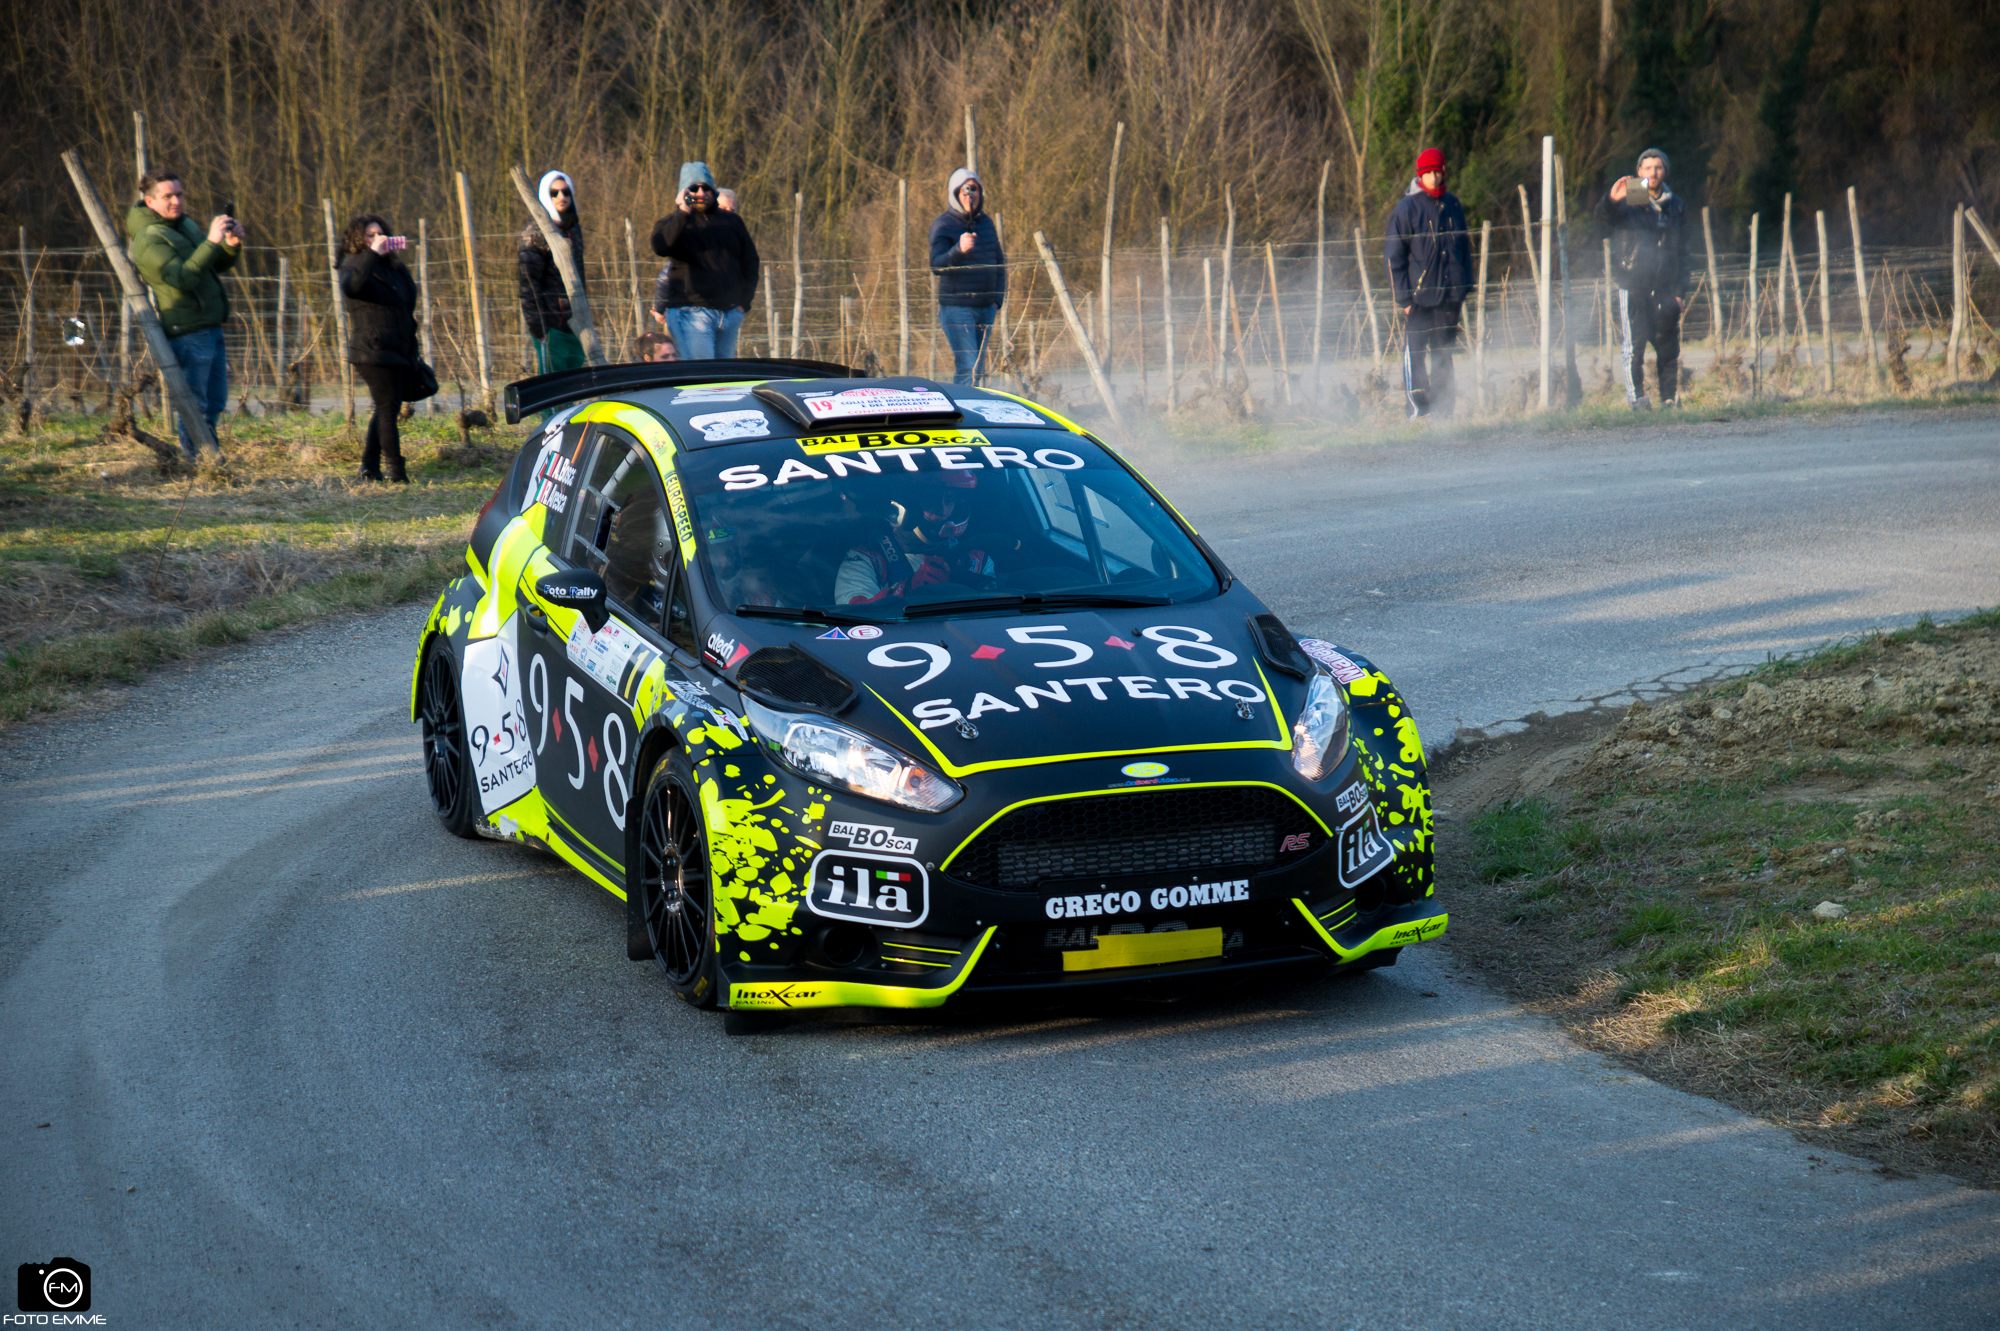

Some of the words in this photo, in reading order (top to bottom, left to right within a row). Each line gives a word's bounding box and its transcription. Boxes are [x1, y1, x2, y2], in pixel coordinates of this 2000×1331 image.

[801, 431, 988, 449] BALBOSCA
[718, 445, 1085, 491] SANTERO
[664, 475, 693, 543] EUROSPEED
[543, 584, 567, 595] Foto
[569, 586, 598, 599] Rally
[912, 675, 1267, 731] SANTERO
[480, 749, 533, 793] SANTERO
[832, 824, 913, 851] BALBOSCA
[1280, 833, 1311, 852] RS
[1346, 826, 1384, 874] ila
[821, 865, 912, 913] ila
[1045, 890, 1142, 919] GRECO
[1150, 879, 1249, 910] GOMME
